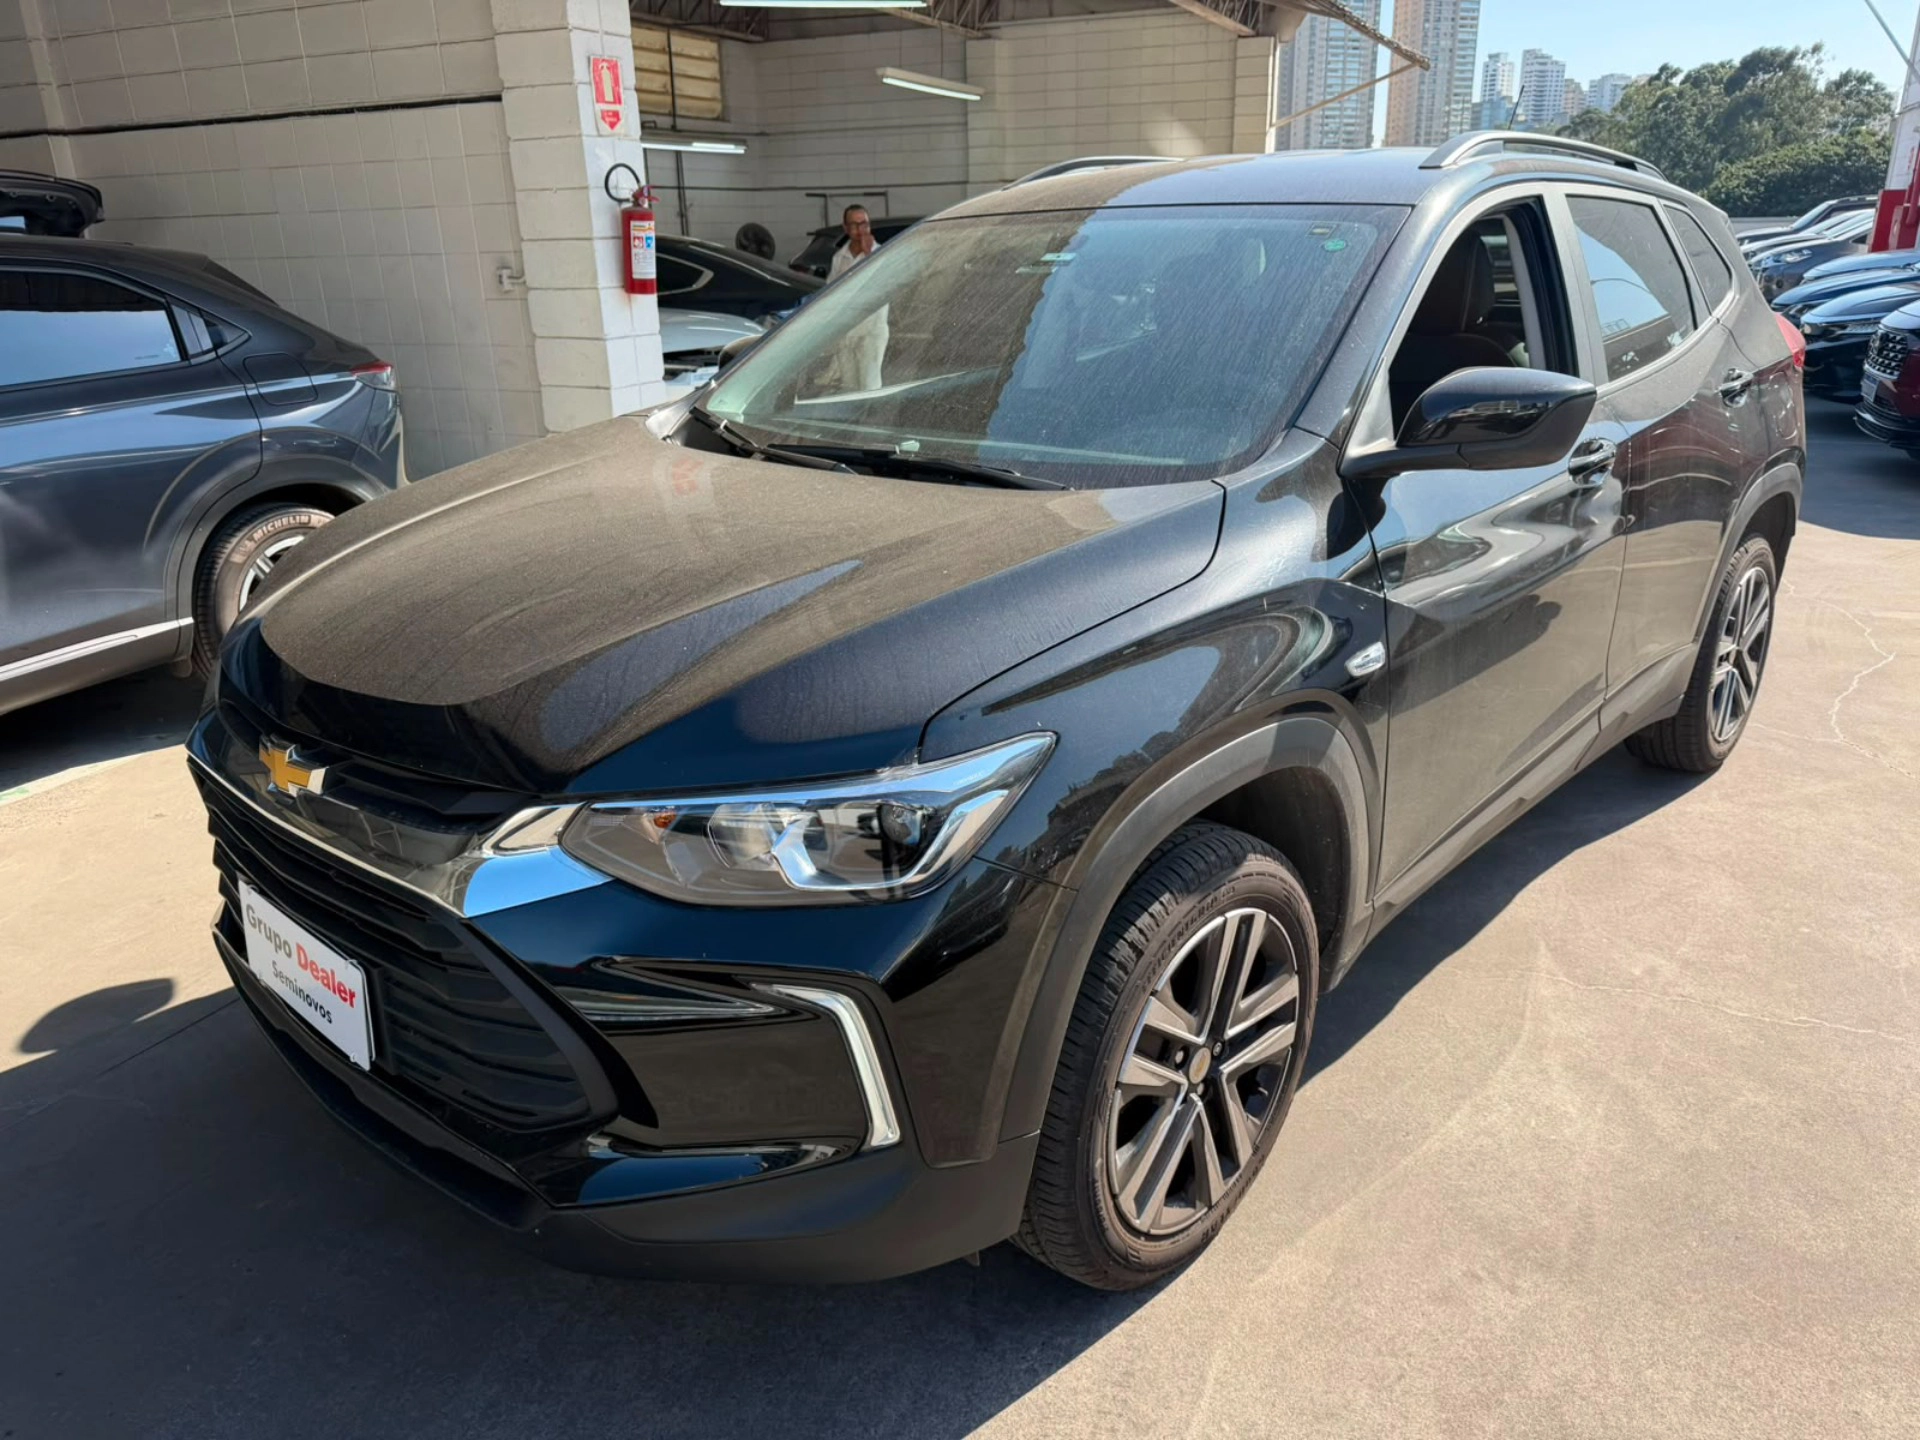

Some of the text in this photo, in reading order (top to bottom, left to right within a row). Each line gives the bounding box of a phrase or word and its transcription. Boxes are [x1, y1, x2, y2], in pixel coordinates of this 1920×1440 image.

[252, 514, 310, 541] MICHELIN
[246, 904, 356, 1008] Grupo Dealer
[272, 961, 333, 1024] Seminovos
